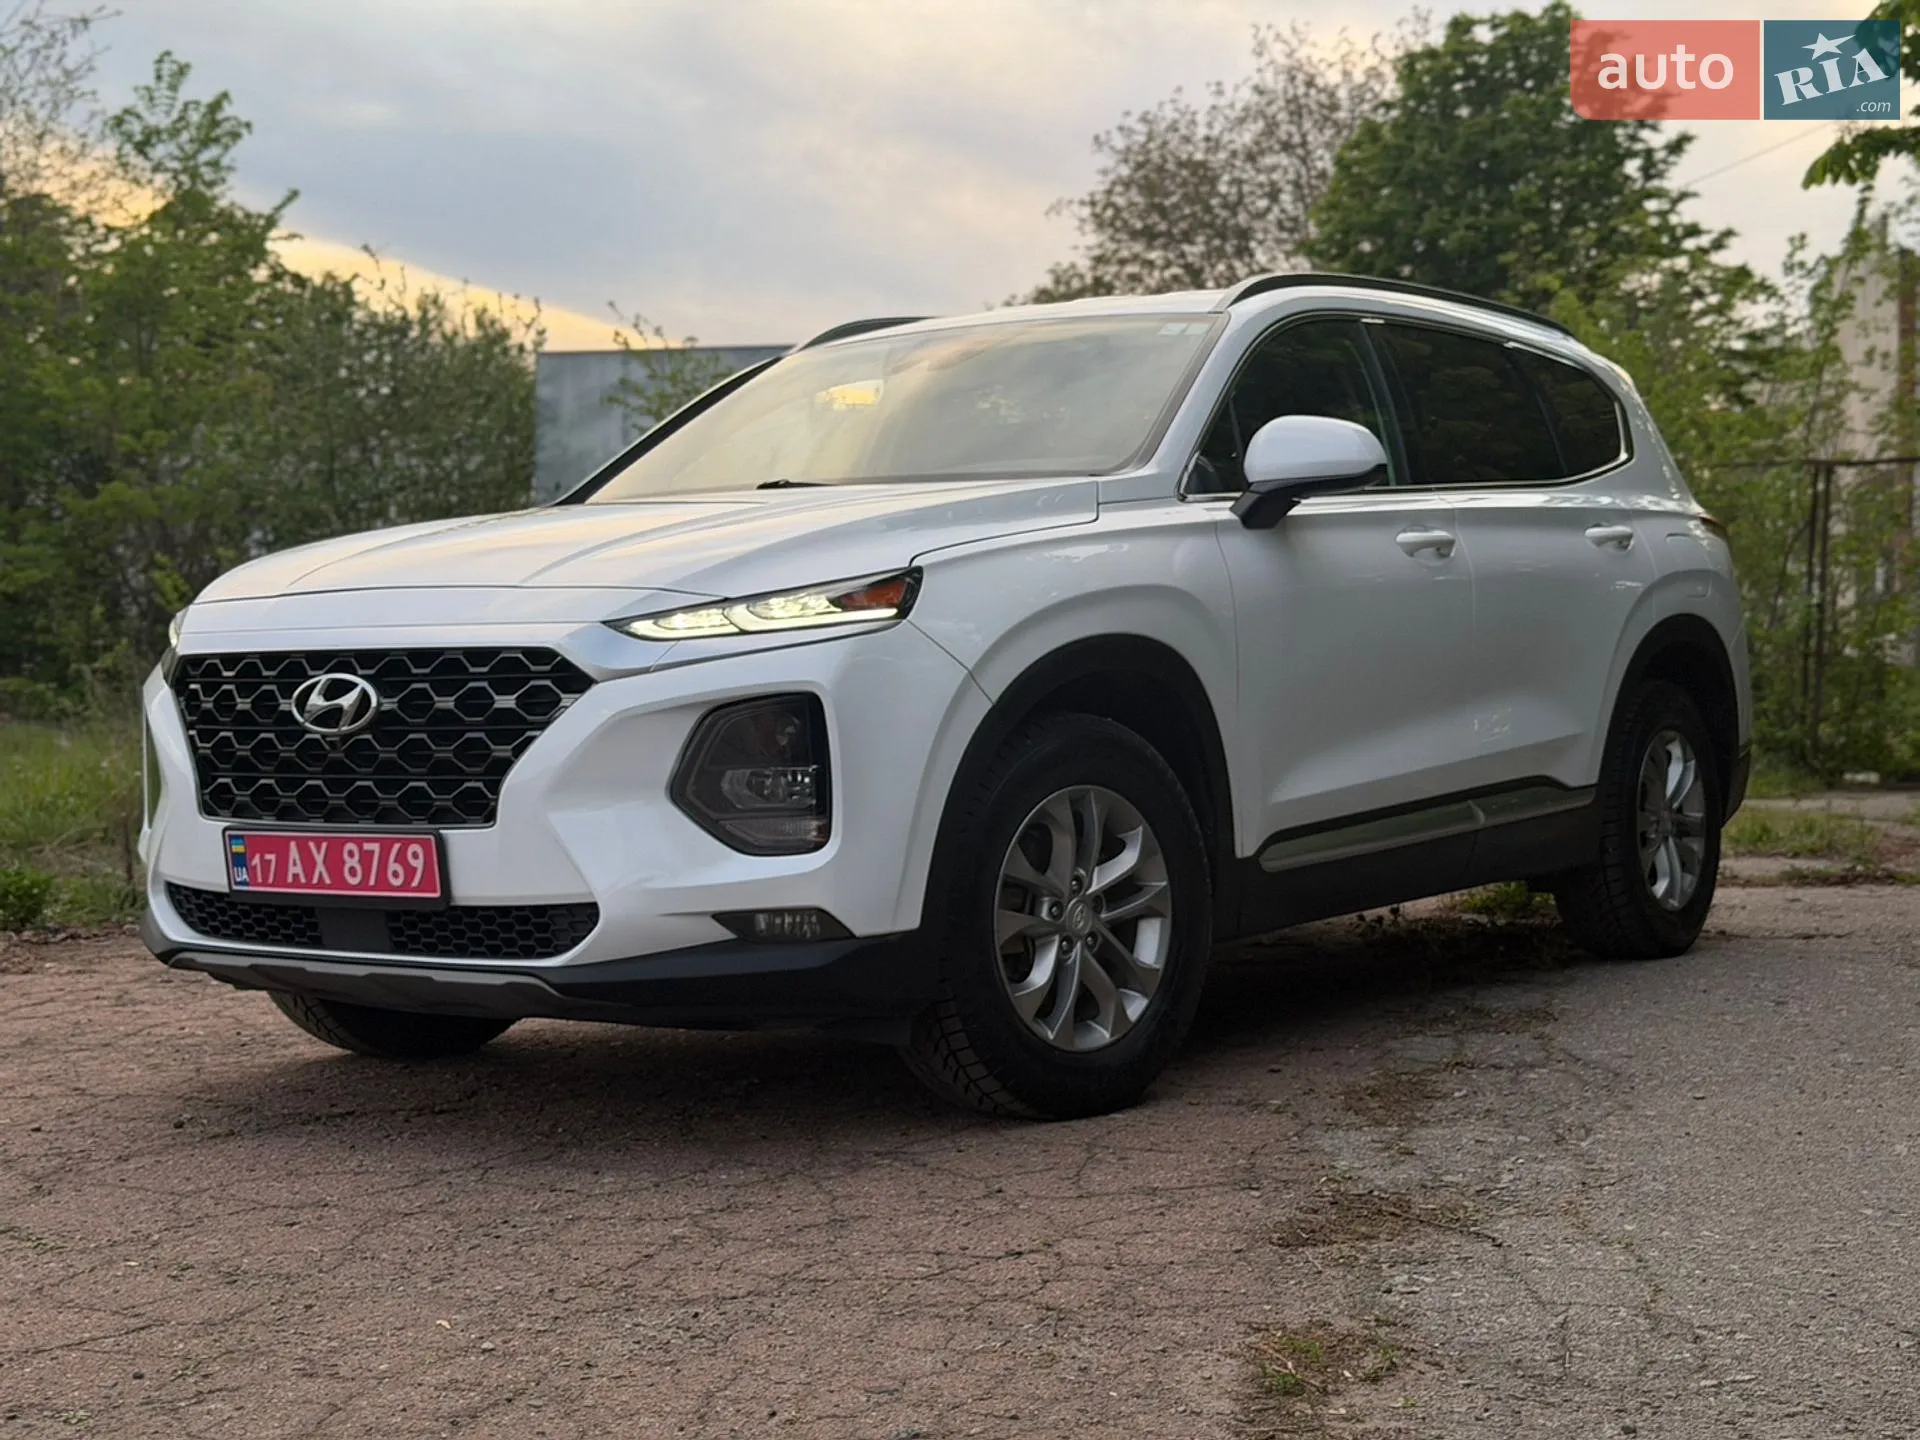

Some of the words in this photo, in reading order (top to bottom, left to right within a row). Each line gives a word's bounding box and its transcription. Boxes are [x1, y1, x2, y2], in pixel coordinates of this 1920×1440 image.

[234, 866, 250, 882] UA
[251, 853, 277, 884] 17
[287, 840, 332, 885] AX
[343, 842, 425, 888] 8769
